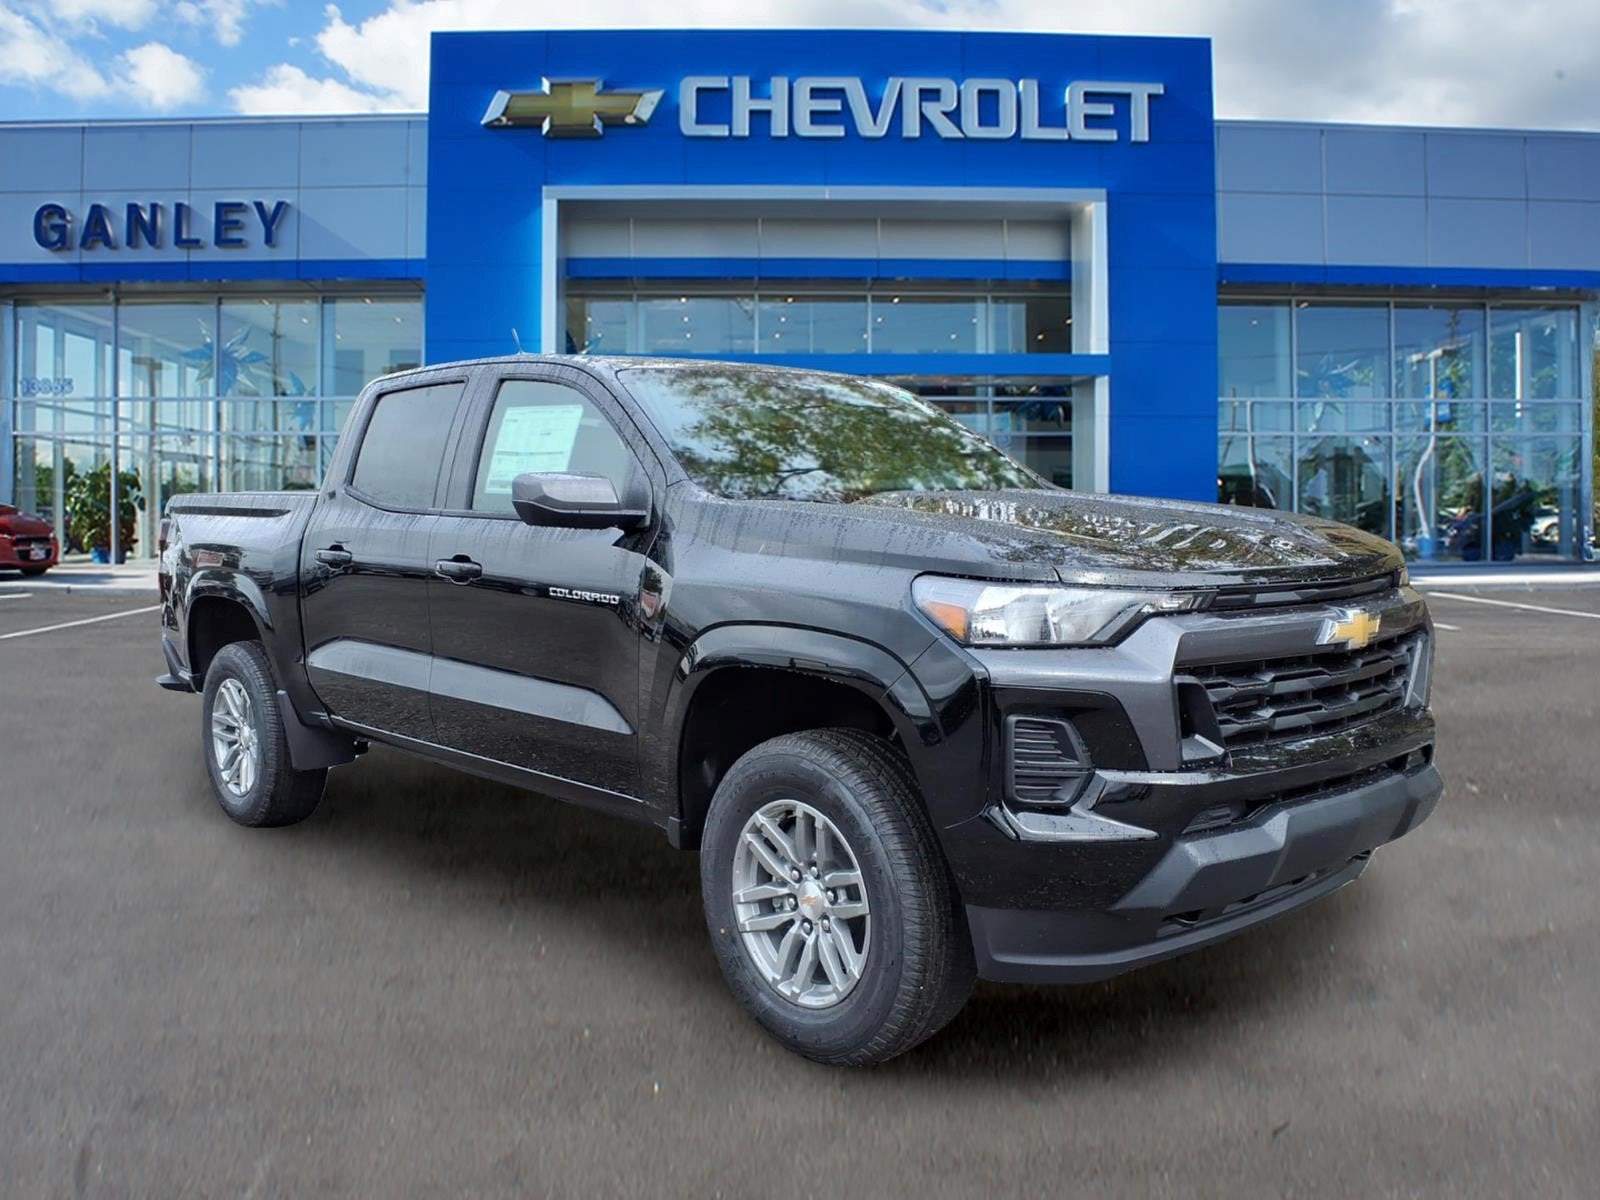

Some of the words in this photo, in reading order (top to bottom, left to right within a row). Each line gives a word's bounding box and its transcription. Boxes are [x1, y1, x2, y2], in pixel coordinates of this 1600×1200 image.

[679, 75, 1165, 142] CHEVROLET
[33, 201, 290, 250] GANLEY
[548, 586, 620, 605] COLORADO
